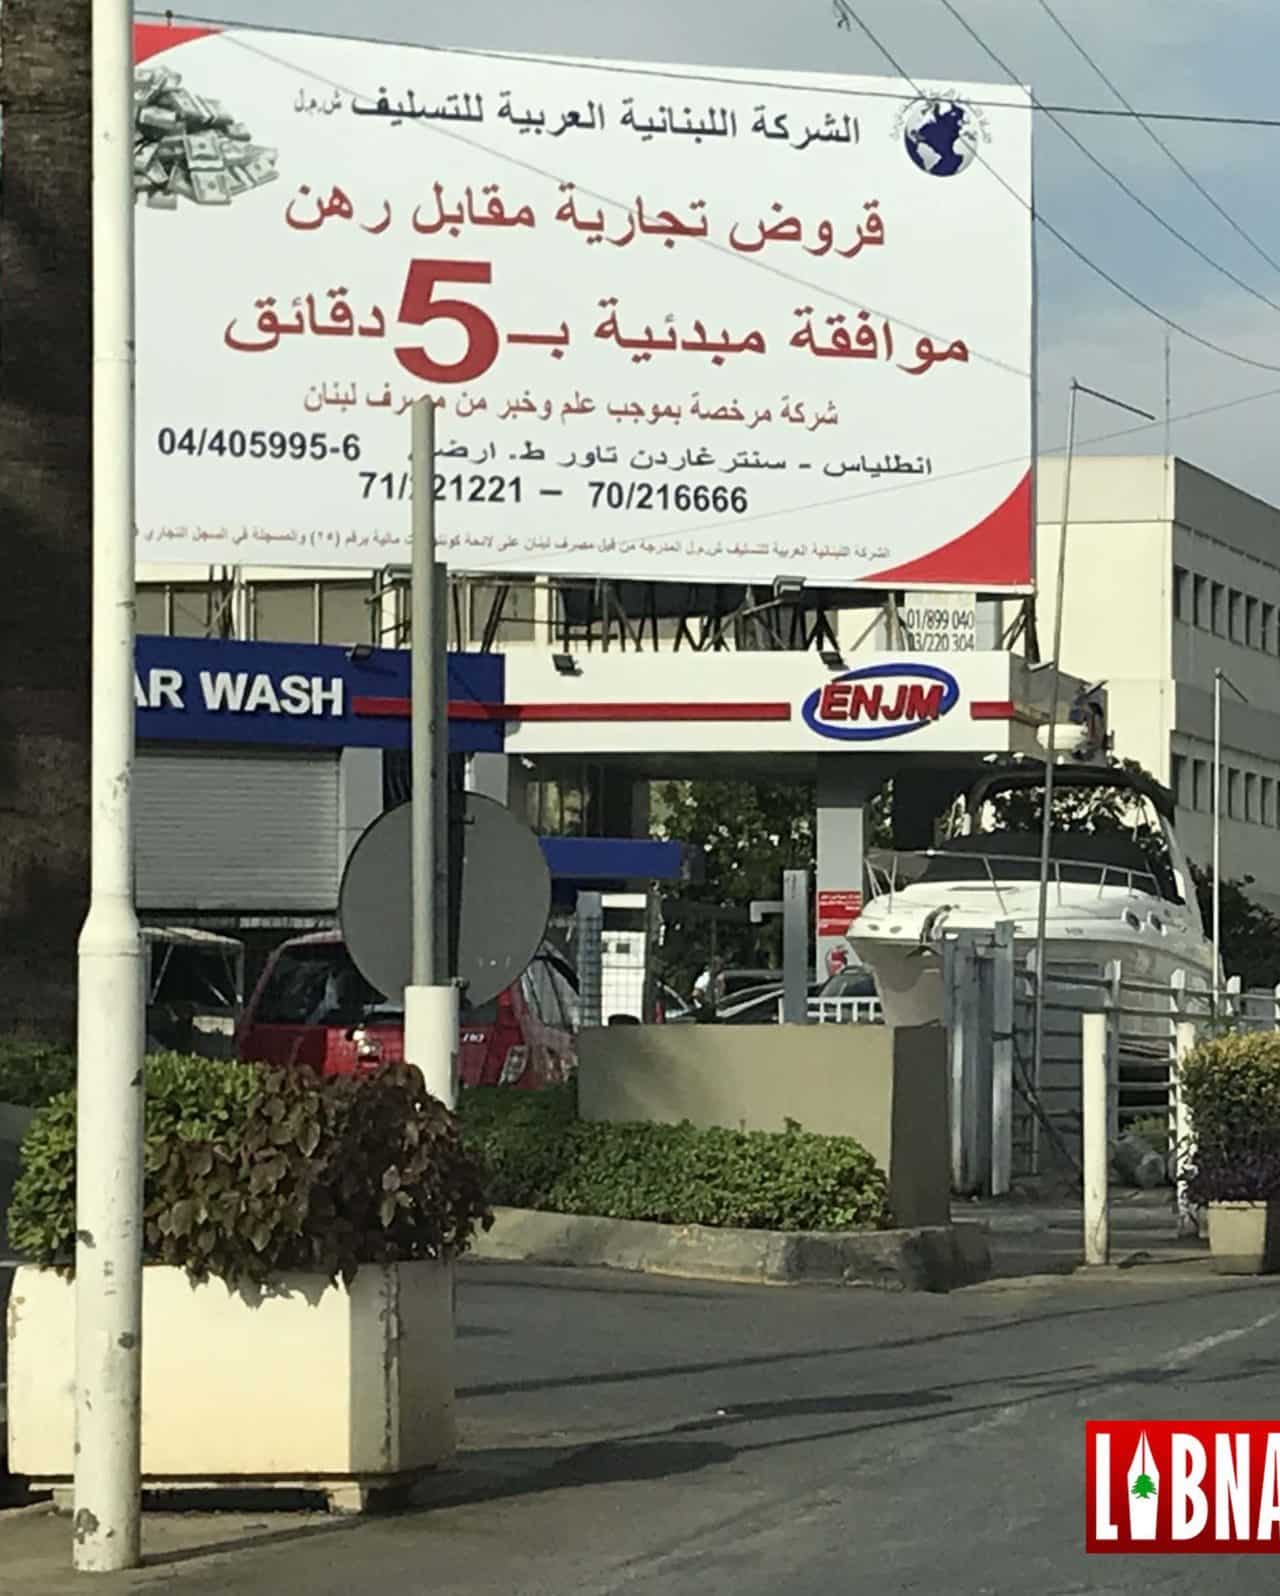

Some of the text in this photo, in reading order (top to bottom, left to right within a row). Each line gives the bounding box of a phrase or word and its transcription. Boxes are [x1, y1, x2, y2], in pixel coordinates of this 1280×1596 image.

[351, 87, 483, 126] للتسليف
[497, 91, 605, 137] العربية
[620, 98, 737, 144] اللبنانية
[752, 105, 859, 150] الشركة
[285, 181, 884, 258] قروض تجارية مقابل رهن
[224, 286, 385, 352] دقائق
[394, 258, 500, 384] 5
[594, 297, 766, 366] مبدئية
[789, 306, 970, 375] موافقة
[304, 382, 357, 412] لبنان
[456, 392, 487, 418] من
[498, 390, 552, 421] وخبر
[561, 391, 596, 423] علم
[607, 402, 682, 425] بموجب
[690, 392, 772, 429] مرخصة
[781, 396, 838, 432] شركة
[158, 427, 360, 461] 04/405995-6
[408, 440, 496, 465] ارض
[558, 445, 618, 468] تاور
[630, 447, 715, 471] غاردن
[823, 454, 932, 478] انطلياس
[359, 473, 522, 503] 71/21221
[588, 481, 748, 514] 70/216666
[199, 670, 344, 717] WASH
[819, 683, 945, 722] ENJM
